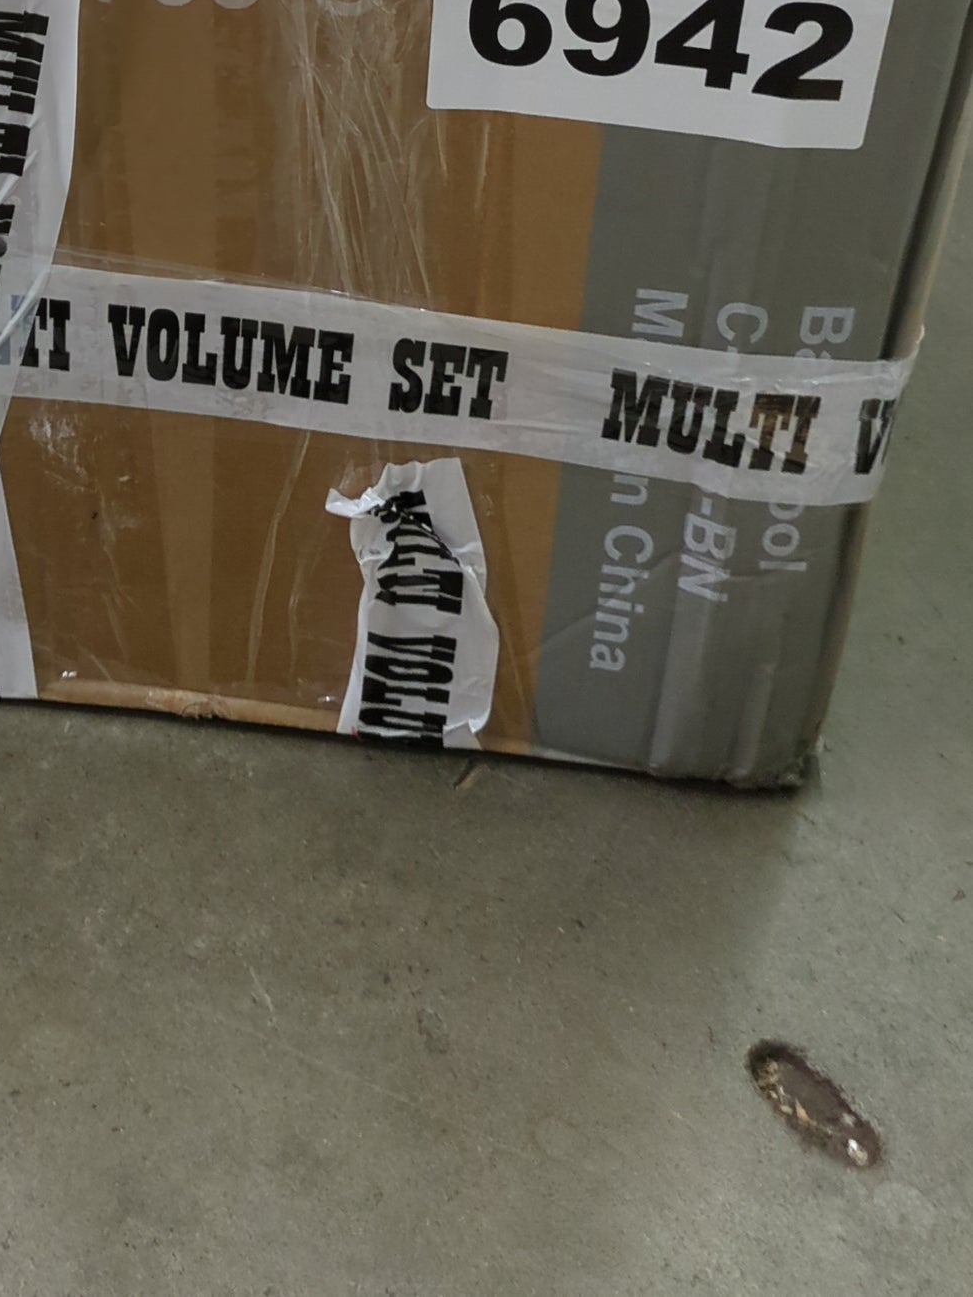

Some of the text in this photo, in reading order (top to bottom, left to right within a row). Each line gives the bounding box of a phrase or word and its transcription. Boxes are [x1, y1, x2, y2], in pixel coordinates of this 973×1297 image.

[107, 303, 355, 404] VOLUME
[388, 337, 510, 420] SET
[601, 368, 822, 476] MULTI
[589, 524, 655, 673] China
[358, 631, 457, 748] VOLU
